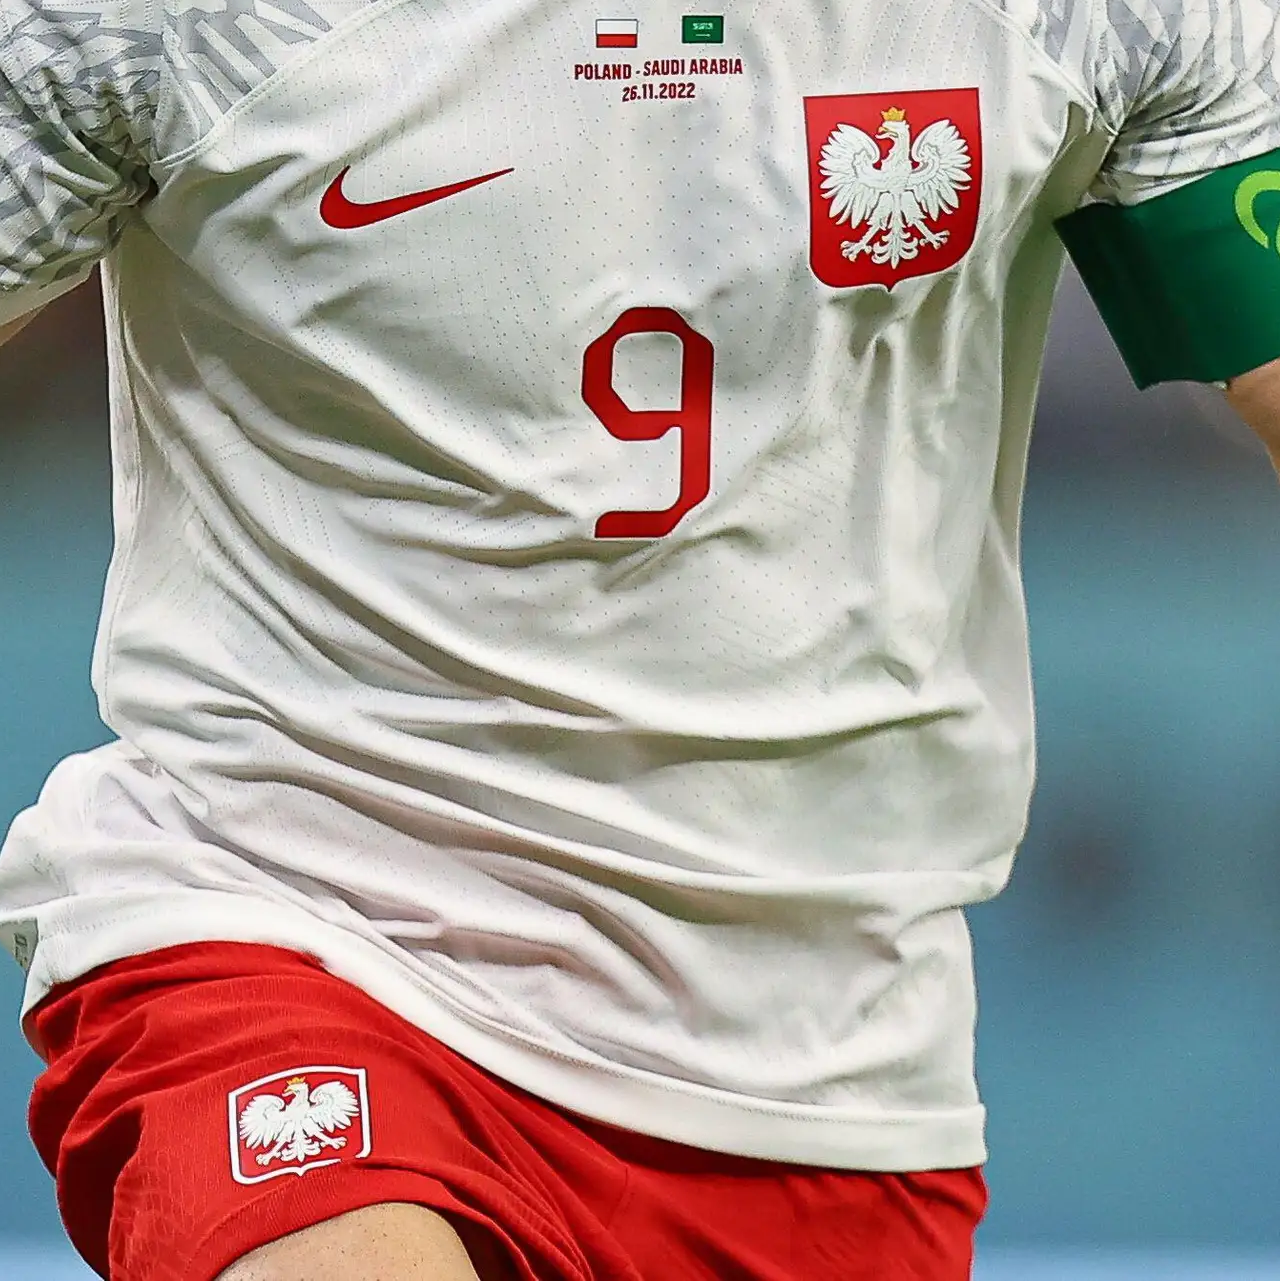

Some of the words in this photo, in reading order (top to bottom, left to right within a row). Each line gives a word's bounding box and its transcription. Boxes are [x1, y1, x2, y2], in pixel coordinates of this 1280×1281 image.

[574, 63, 632, 80] POLAND
[643, 59, 685, 77] SAUDI
[687, 58, 744, 76] ARABIA
[622, 82, 697, 103] 26.11.2022
[581, 306, 714, 538] 9
